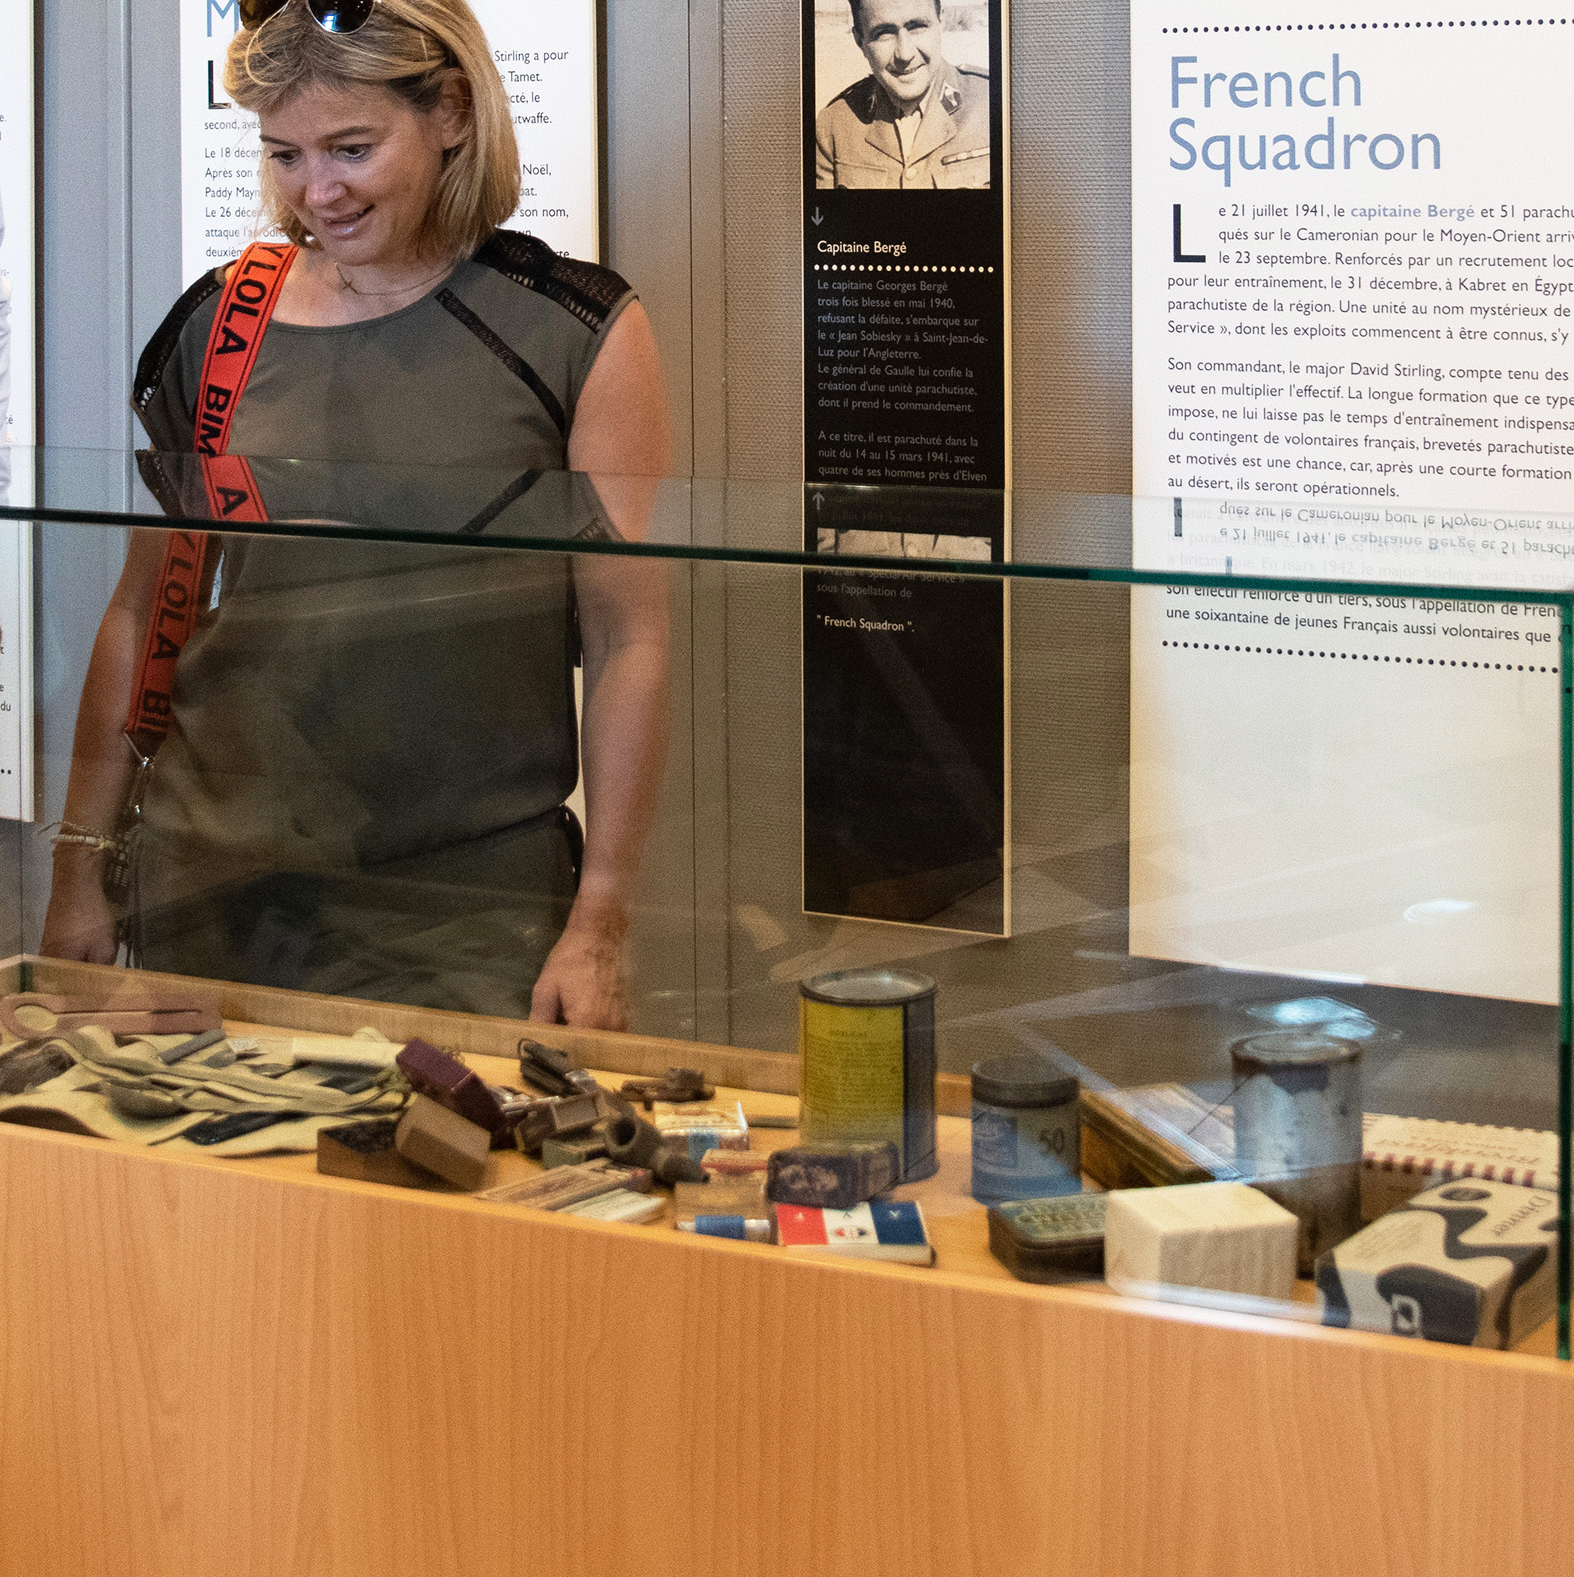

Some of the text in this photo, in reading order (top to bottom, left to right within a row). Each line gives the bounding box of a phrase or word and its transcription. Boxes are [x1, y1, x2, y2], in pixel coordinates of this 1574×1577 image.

[494, 49, 569, 63] Stirling a pour
[508, 70, 543, 82] Tamet.
[1170, 53, 1362, 109] French
[1168, 116, 1442, 188] Squadron
[522, 163, 552, 177] Noël,
[1230, 203, 1246, 219] 21
[1251, 203, 1289, 222] juillet
[1295, 203, 1331, 219] 1941,
[1333, 204, 1346, 219] le
[1350, 204, 1422, 222] capitaine
[1427, 203, 1475, 223] Bergé
[1479, 207, 1496, 219] et
[1499, 203, 1516, 219] 51
[1217, 228, 1250, 245] qués
[1253, 230, 1276, 242] sur
[1279, 227, 1292, 242] le
[1295, 226, 1380, 243] Cameronian
[1383, 231, 1418, 246] pour
[1422, 228, 1435, 243] le
[1439, 227, 1542, 247] Moyen-Orient
[816, 239, 907, 258] Capitaine Bergé
[816, 279, 948, 295] Le capitaine Georges Bergé
[215, 259, 277, 355] LOLA
[152, 556, 194, 660] LOLA
[825, 616, 904, 632] French Squadron
